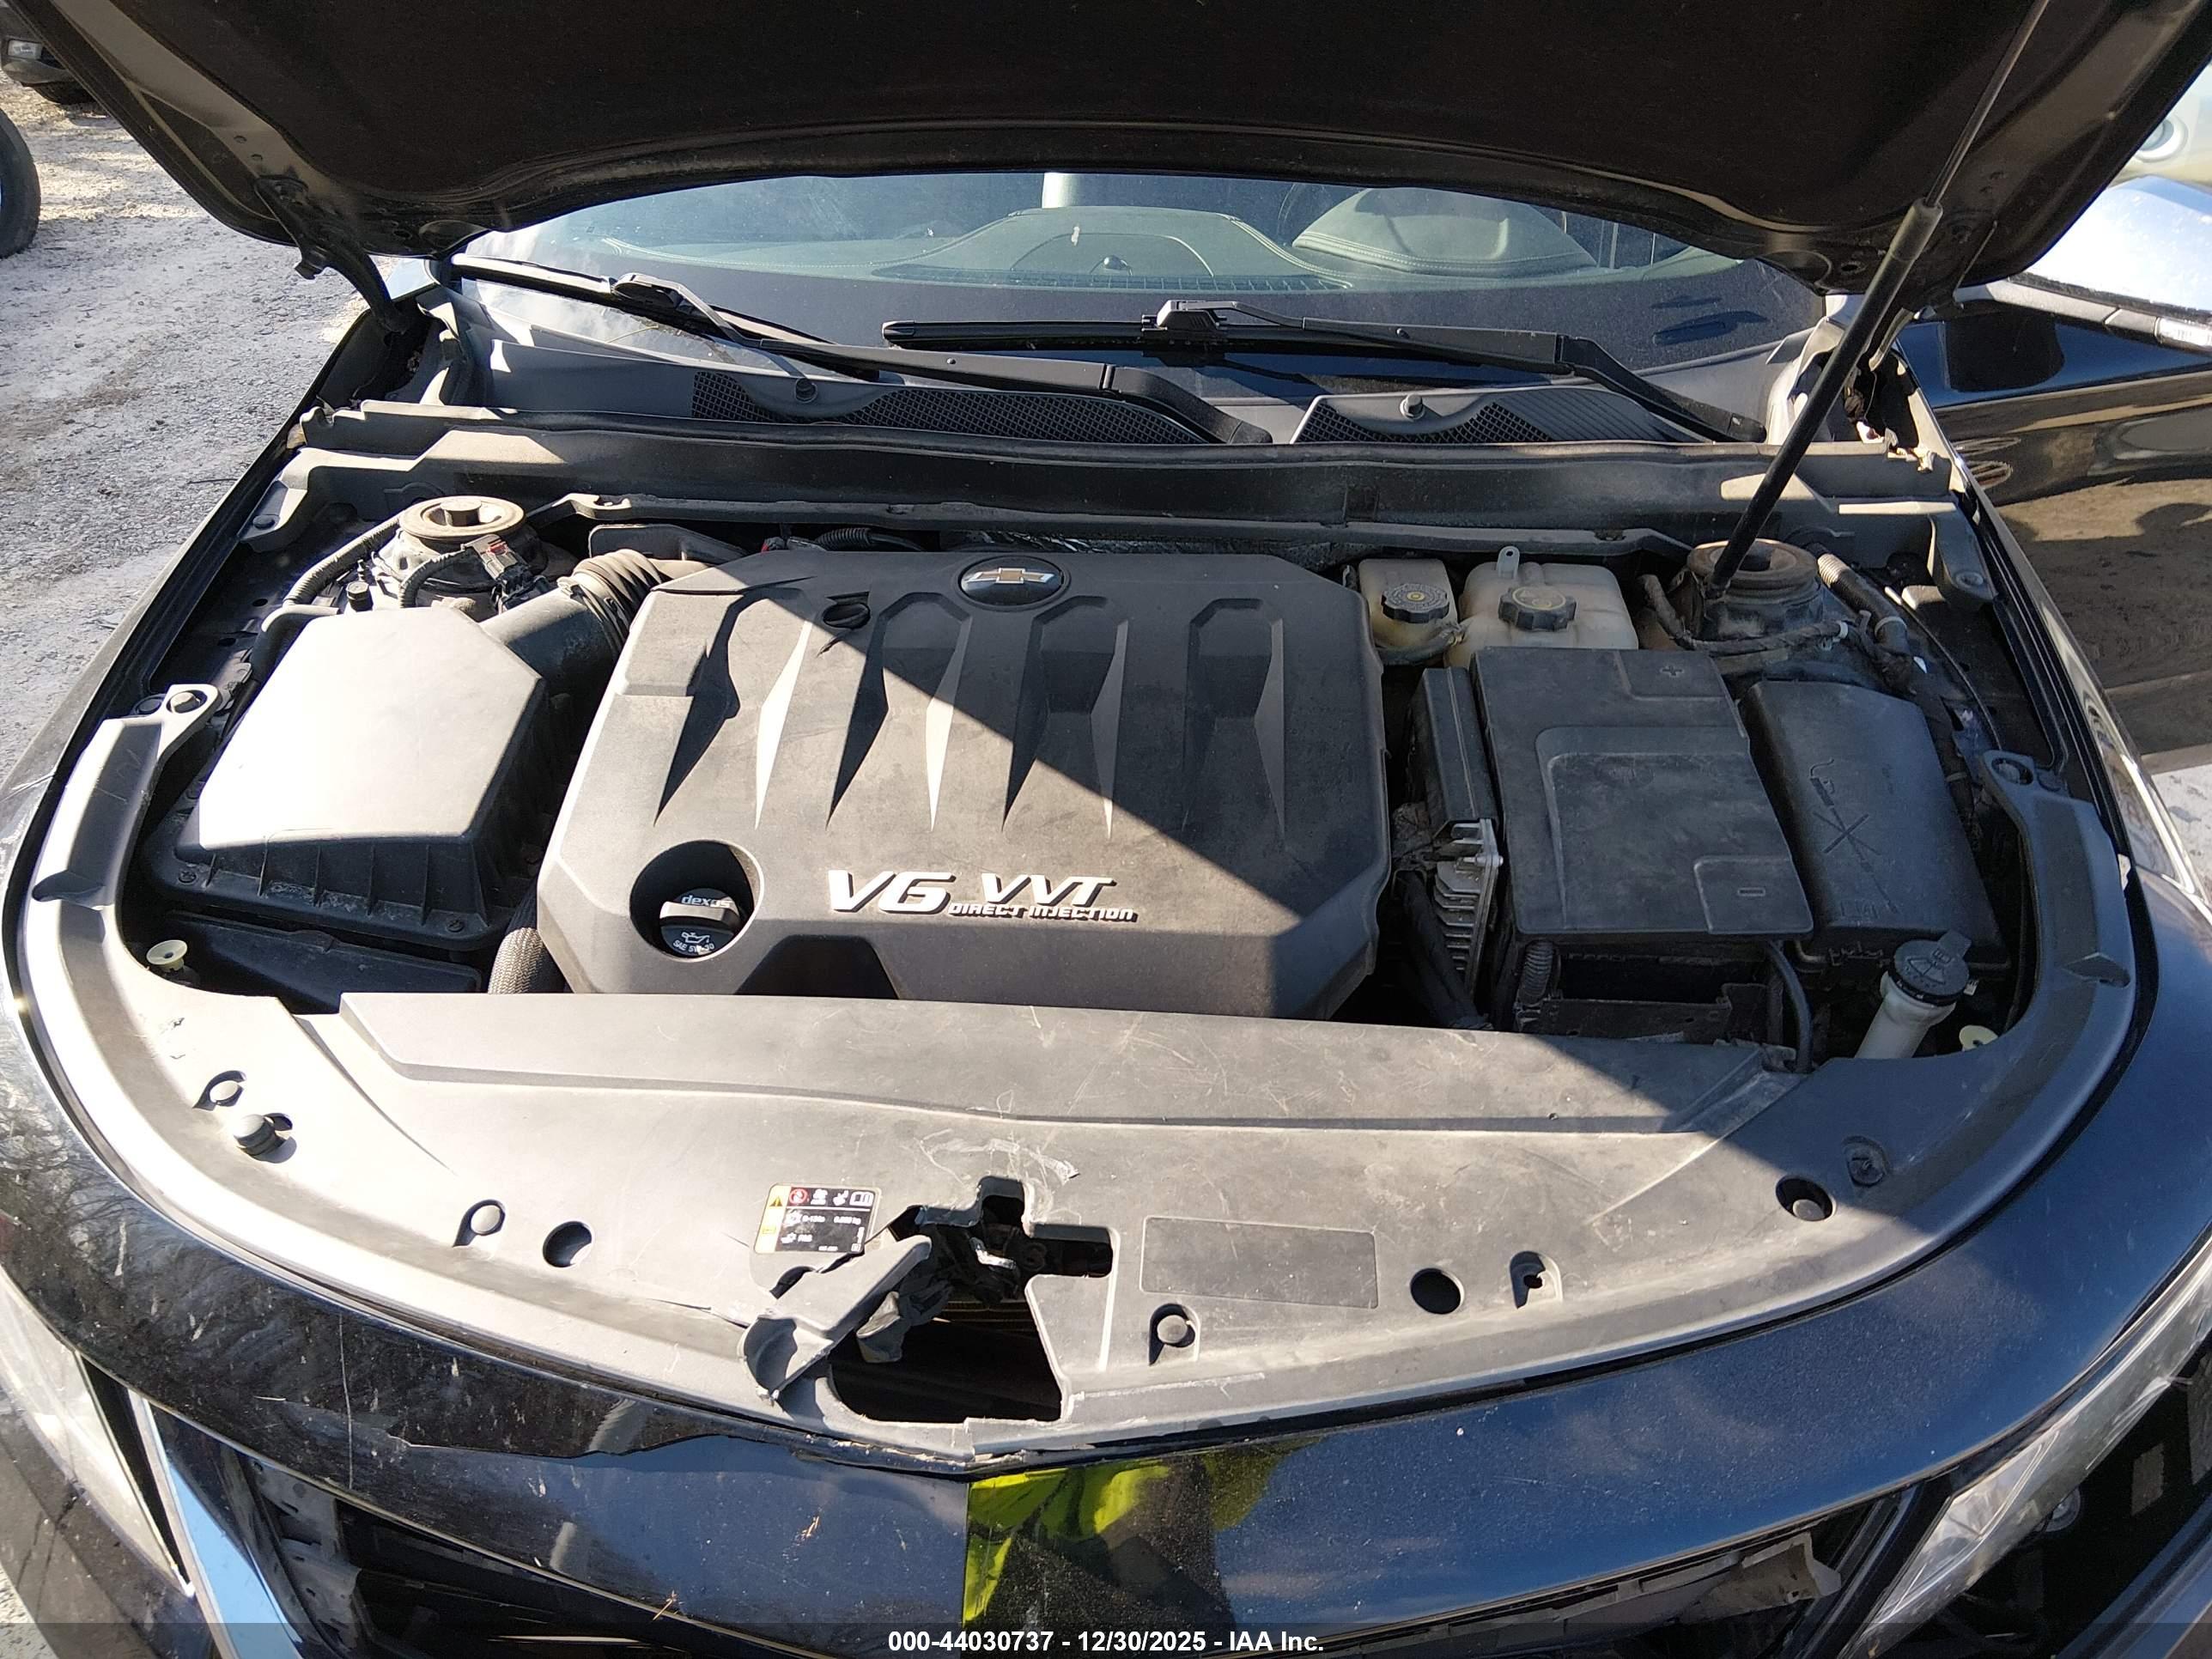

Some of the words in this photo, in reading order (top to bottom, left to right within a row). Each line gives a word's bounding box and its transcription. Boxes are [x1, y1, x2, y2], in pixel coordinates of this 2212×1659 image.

[828, 869, 956, 914] V6
[981, 872, 1116, 908] VVT
[681, 895, 732, 908] dexos
[948, 902, 1029, 921] DIRECT
[1029, 905, 1139, 923] INJECTION
[672, 939, 688, 951] SAE
